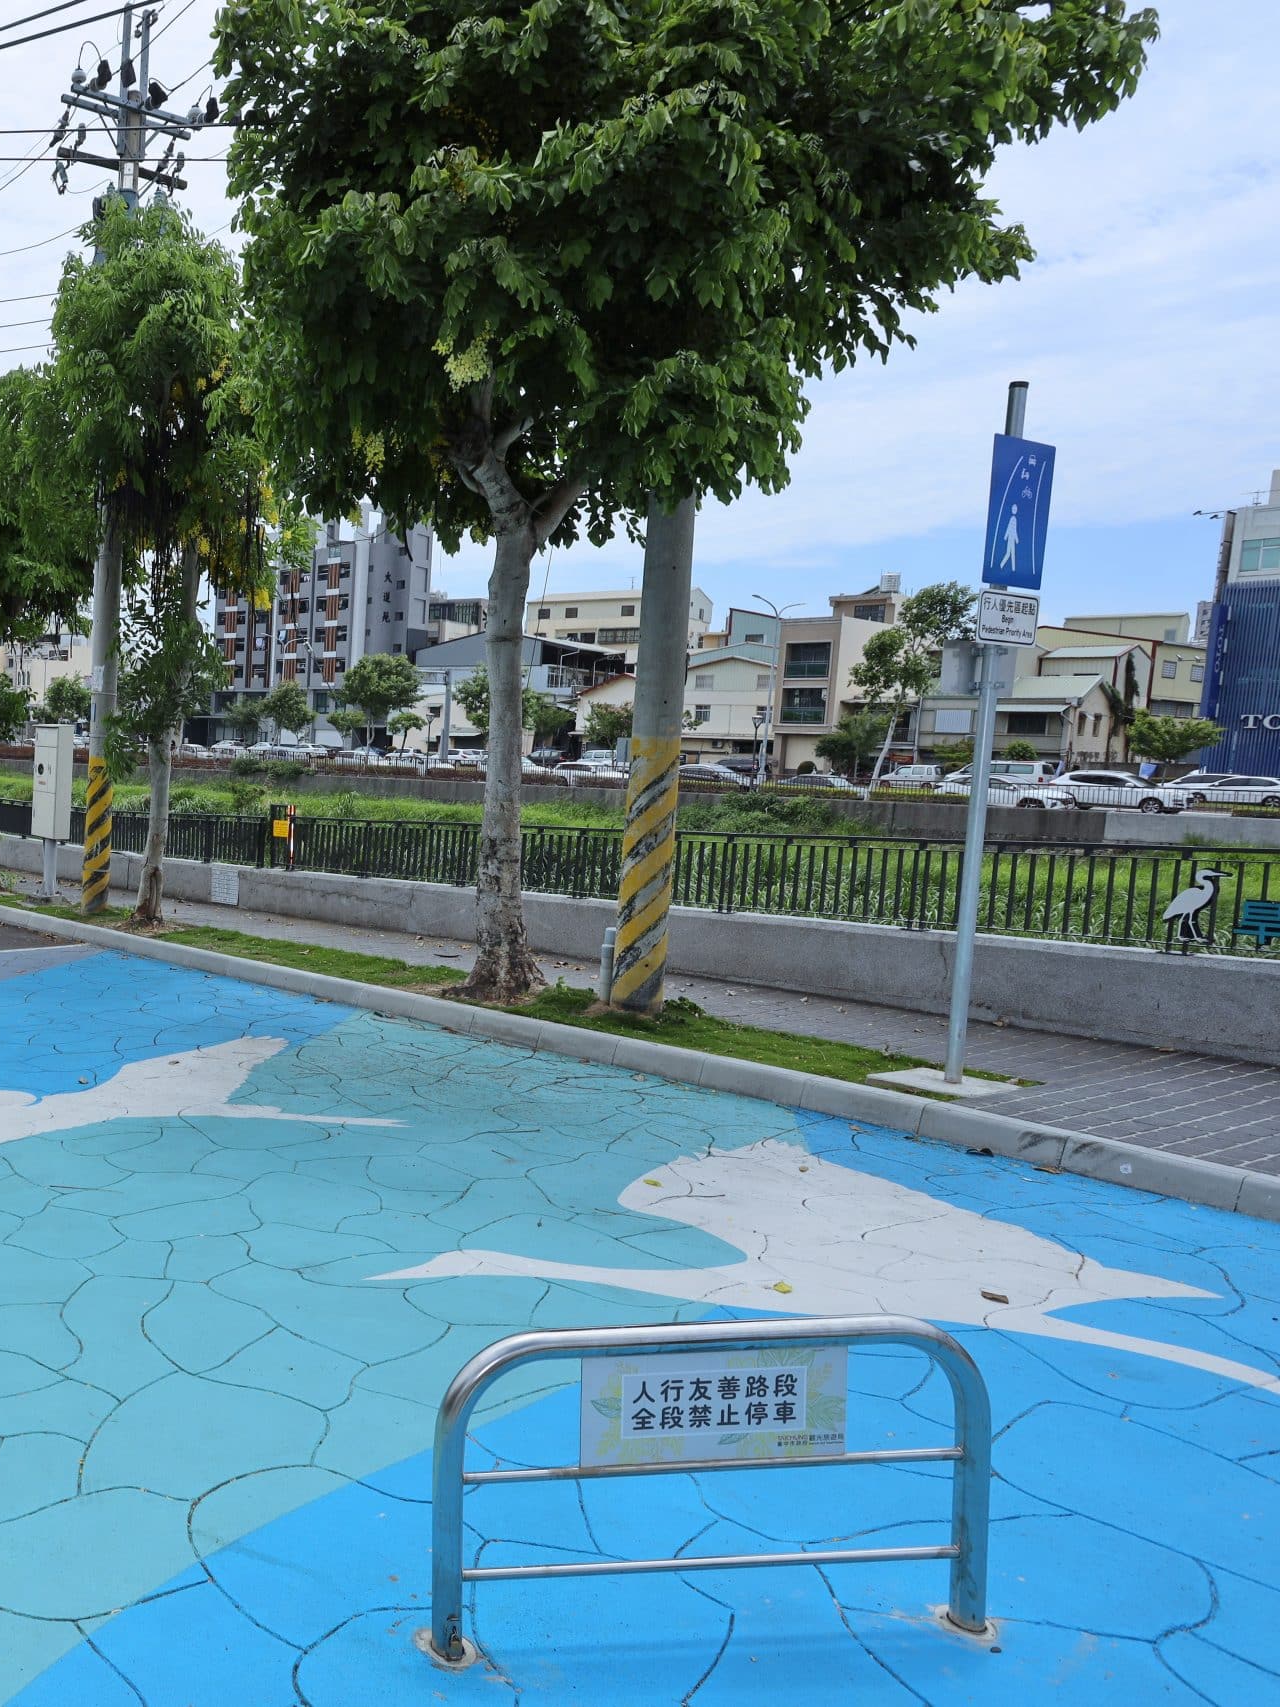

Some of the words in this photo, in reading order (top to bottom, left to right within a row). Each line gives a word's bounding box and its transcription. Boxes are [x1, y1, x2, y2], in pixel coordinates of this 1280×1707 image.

[983, 596, 1037, 615] 行人優先區起點
[1001, 614, 1014, 625] Begin
[982, 624, 1005, 635] Pedestrian
[1006, 627, 1021, 639] Priority
[1022, 629, 1033, 638] Area
[632, 1374, 798, 1404] 人行友善路段
[631, 1400, 797, 1431] 全段禁止停車
